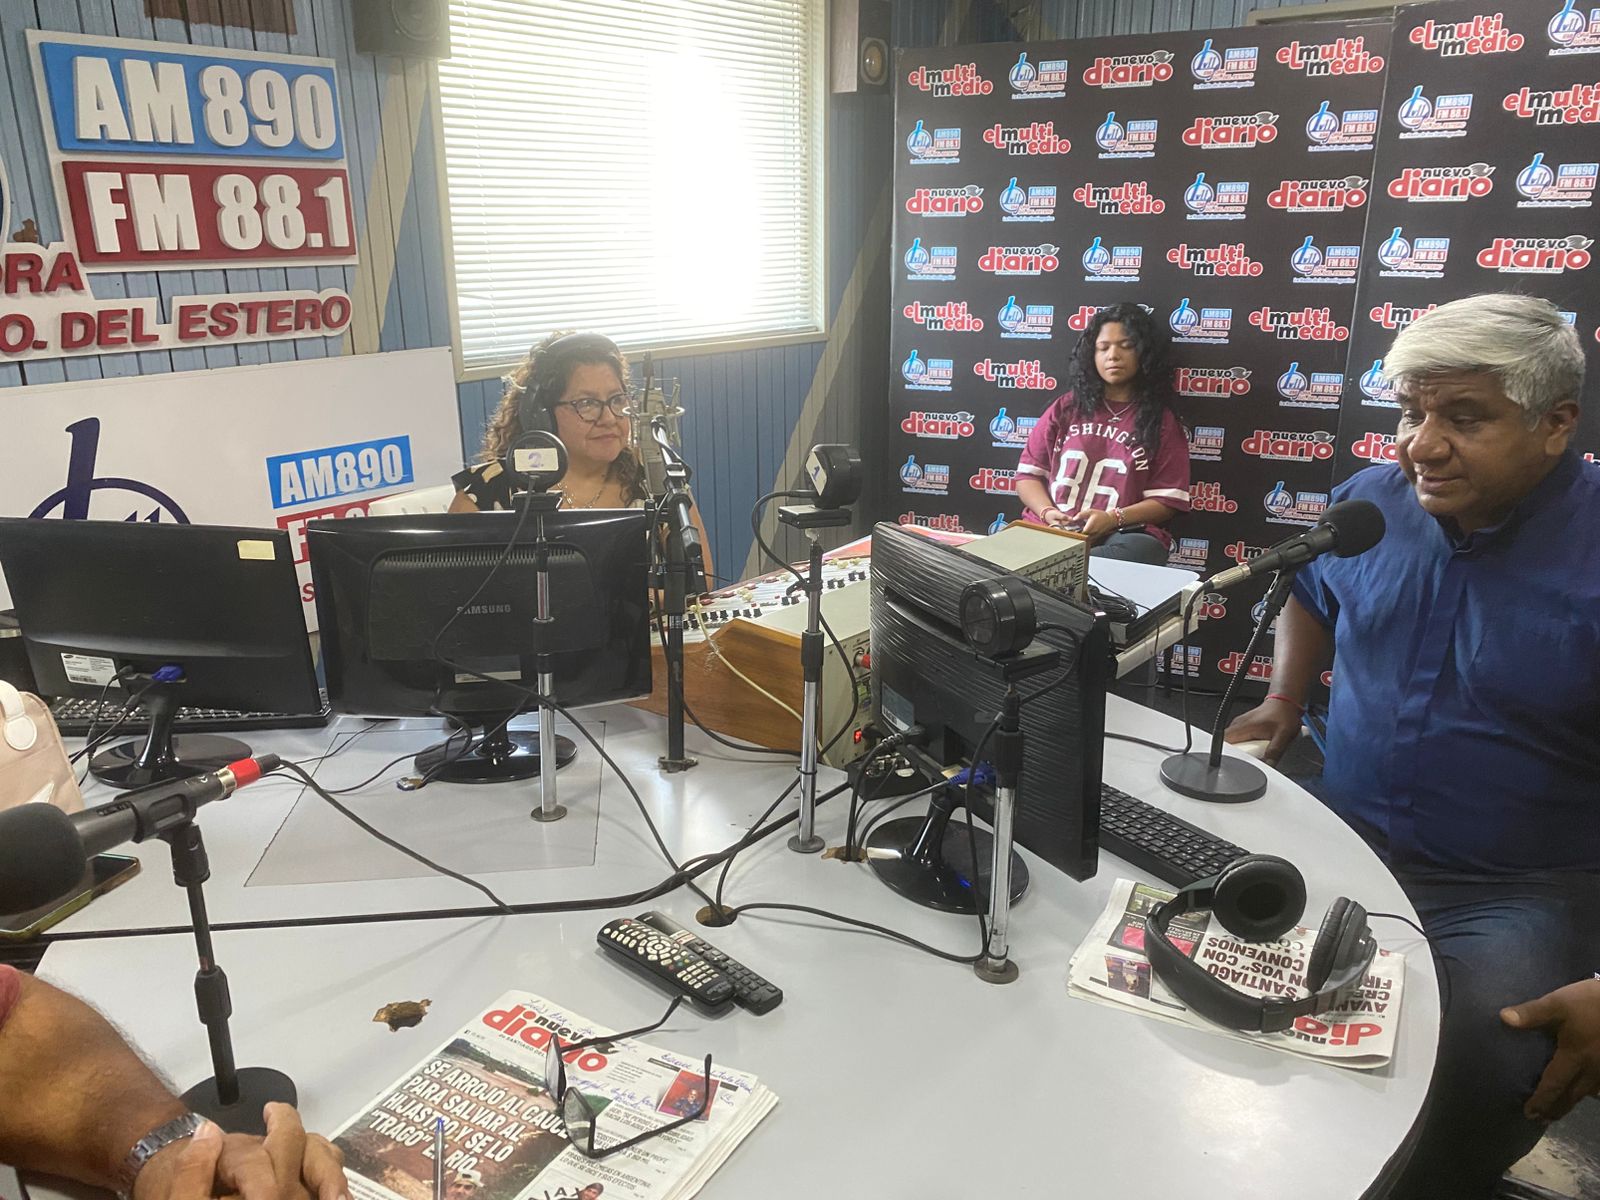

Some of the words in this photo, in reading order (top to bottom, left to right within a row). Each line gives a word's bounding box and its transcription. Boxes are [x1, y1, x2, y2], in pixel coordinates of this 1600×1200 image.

[1441, 28, 1524, 56] medio
[1112, 54, 1154, 65] nuevo
[1307, 51, 1384, 76] medio
[1083, 57, 1173, 86] diario
[933, 78, 993, 97] medio
[72, 56, 195, 145] AM
[198, 64, 337, 150] 890
[1536, 100, 1600, 125] med
[1182, 117, 1277, 147] diario
[1213, 115, 1258, 126] nuevo
[1009, 137, 1071, 155] medio
[1422, 166, 1471, 178] nuevo
[931, 187, 967, 197] nuevo
[1267, 180, 1367, 208] diario
[1300, 179, 1347, 190] nuevo
[1387, 169, 1493, 199] diario
[82, 171, 201, 253] FM
[213, 173, 350, 251] 88.1
[906, 188, 983, 214] diario
[1101, 195, 1165, 215] medio
[1004, 246, 1042, 256] nuevo
[1477, 238, 1591, 270] diario
[1514, 239, 1569, 250] nuevo
[978, 247, 1059, 274] diario
[1194, 256, 1263, 277] medio
[61, 308, 160, 349] DEL
[178, 295, 352, 341] ESTERO
[928, 313, 984, 331] medio
[1277, 319, 1349, 341] medio
[999, 373, 1057, 390] medio
[1190, 368, 1232, 378] nuevo
[901, 412, 974, 438] diario
[924, 412, 958, 422] nuevo
[1242, 430, 1334, 460] diario
[1272, 431, 1315, 442] nuevo
[280, 444, 403, 504] AM890
[1051, 450, 1127, 512] 86
[1190, 494, 1238, 514] edio
[457, 604, 511, 615] SAMSUNG
[1202, 949, 1239, 966] CON
[1207, 937, 1304, 972] CONVENIOS
[423, 1060, 452, 1075] SE
[442, 1068, 508, 1105] ARROJÓ
[498, 1097, 525, 1116] AL
[402, 1075, 444, 1106] PARA
[441, 1094, 506, 1132] SALVAR
[499, 1123, 525, 1143] AL
[452, 1126, 473, 1143] Y
[464, 1131, 495, 1153] SE
[485, 1141, 515, 1162] LO
[444, 1150, 480, 1172] RÍO
